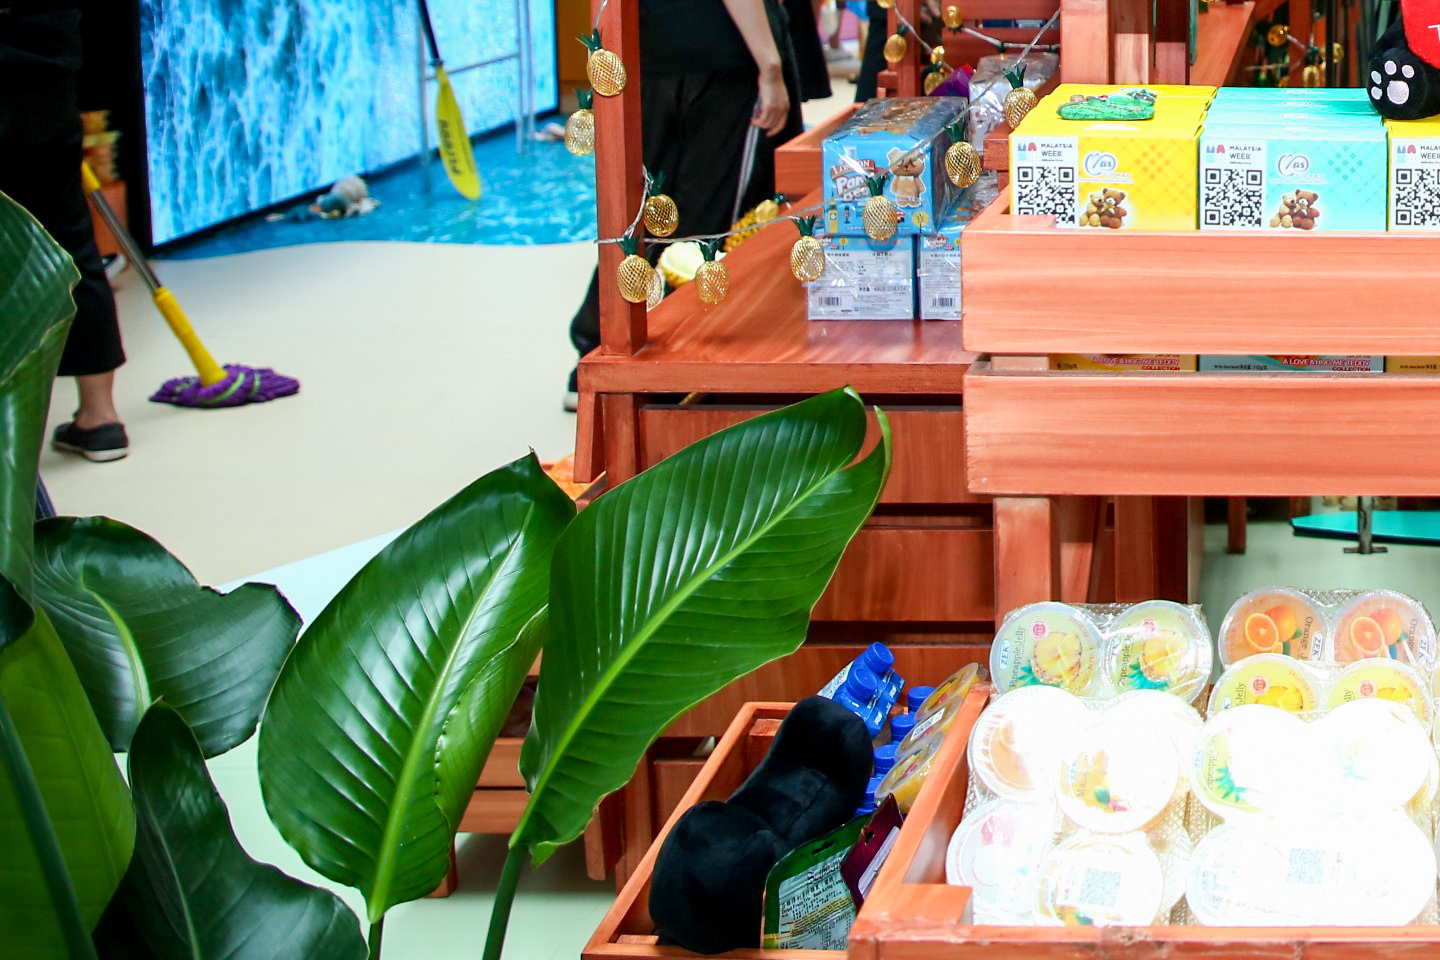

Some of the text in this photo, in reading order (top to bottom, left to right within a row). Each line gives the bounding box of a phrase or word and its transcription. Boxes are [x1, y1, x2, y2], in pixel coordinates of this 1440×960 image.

[1299, 616, 1313, 650] Orange
[1001, 644, 1010, 666] ZEK
[1313, 636, 1322, 660] ZEK
